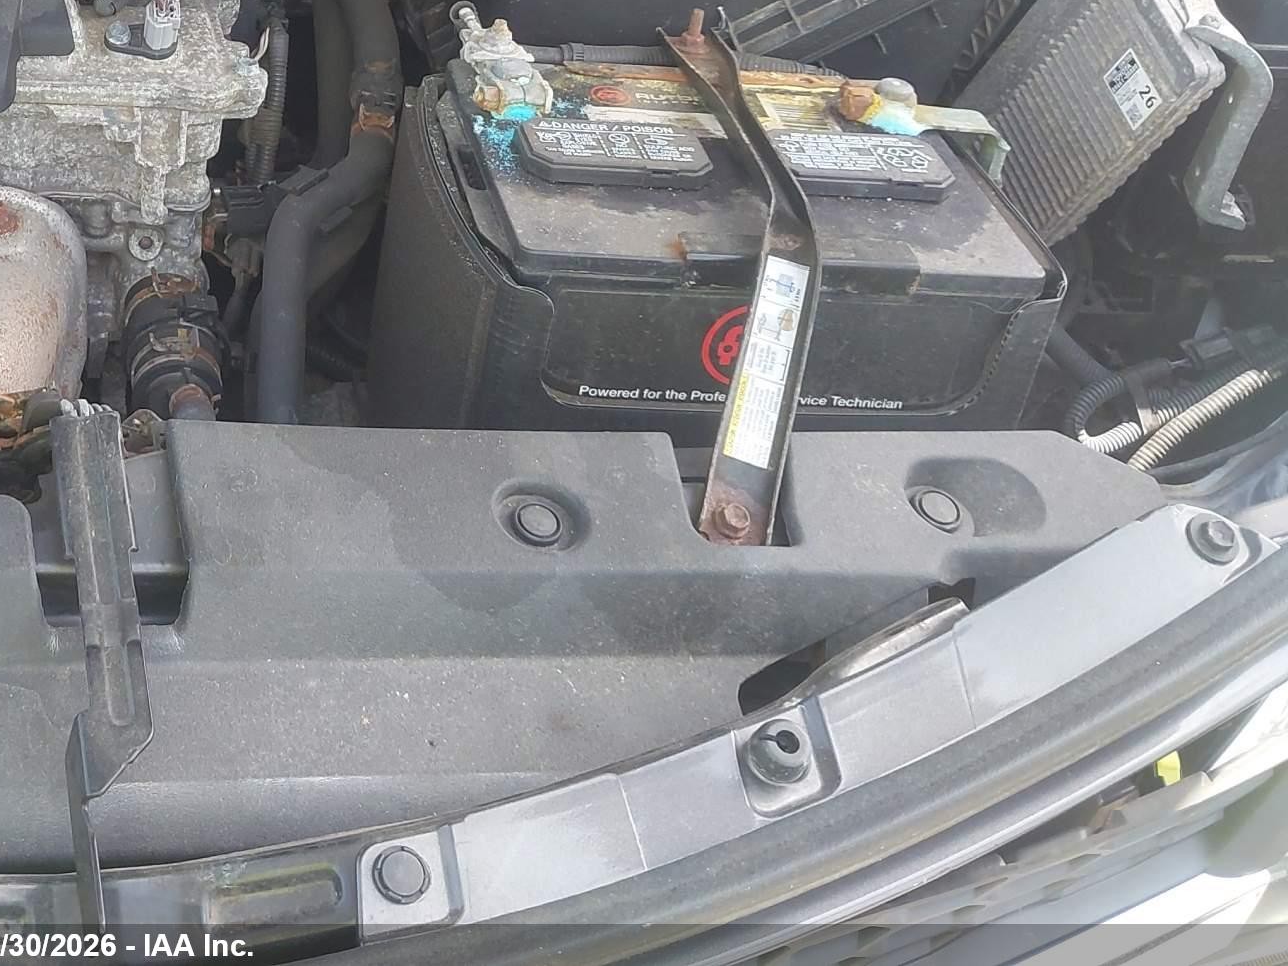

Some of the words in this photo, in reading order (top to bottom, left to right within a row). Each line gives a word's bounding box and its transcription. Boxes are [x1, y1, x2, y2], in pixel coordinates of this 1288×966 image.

[1138, 85, 1158, 109] 26
[551, 121, 609, 131] DANGER
[622, 125, 674, 134] POISON
[578, 385, 639, 400] Powered
[643, 388, 662, 400] for
[665, 389, 687, 401] the
[691, 390, 727, 402] Profe
[831, 395, 903, 410] Technician
